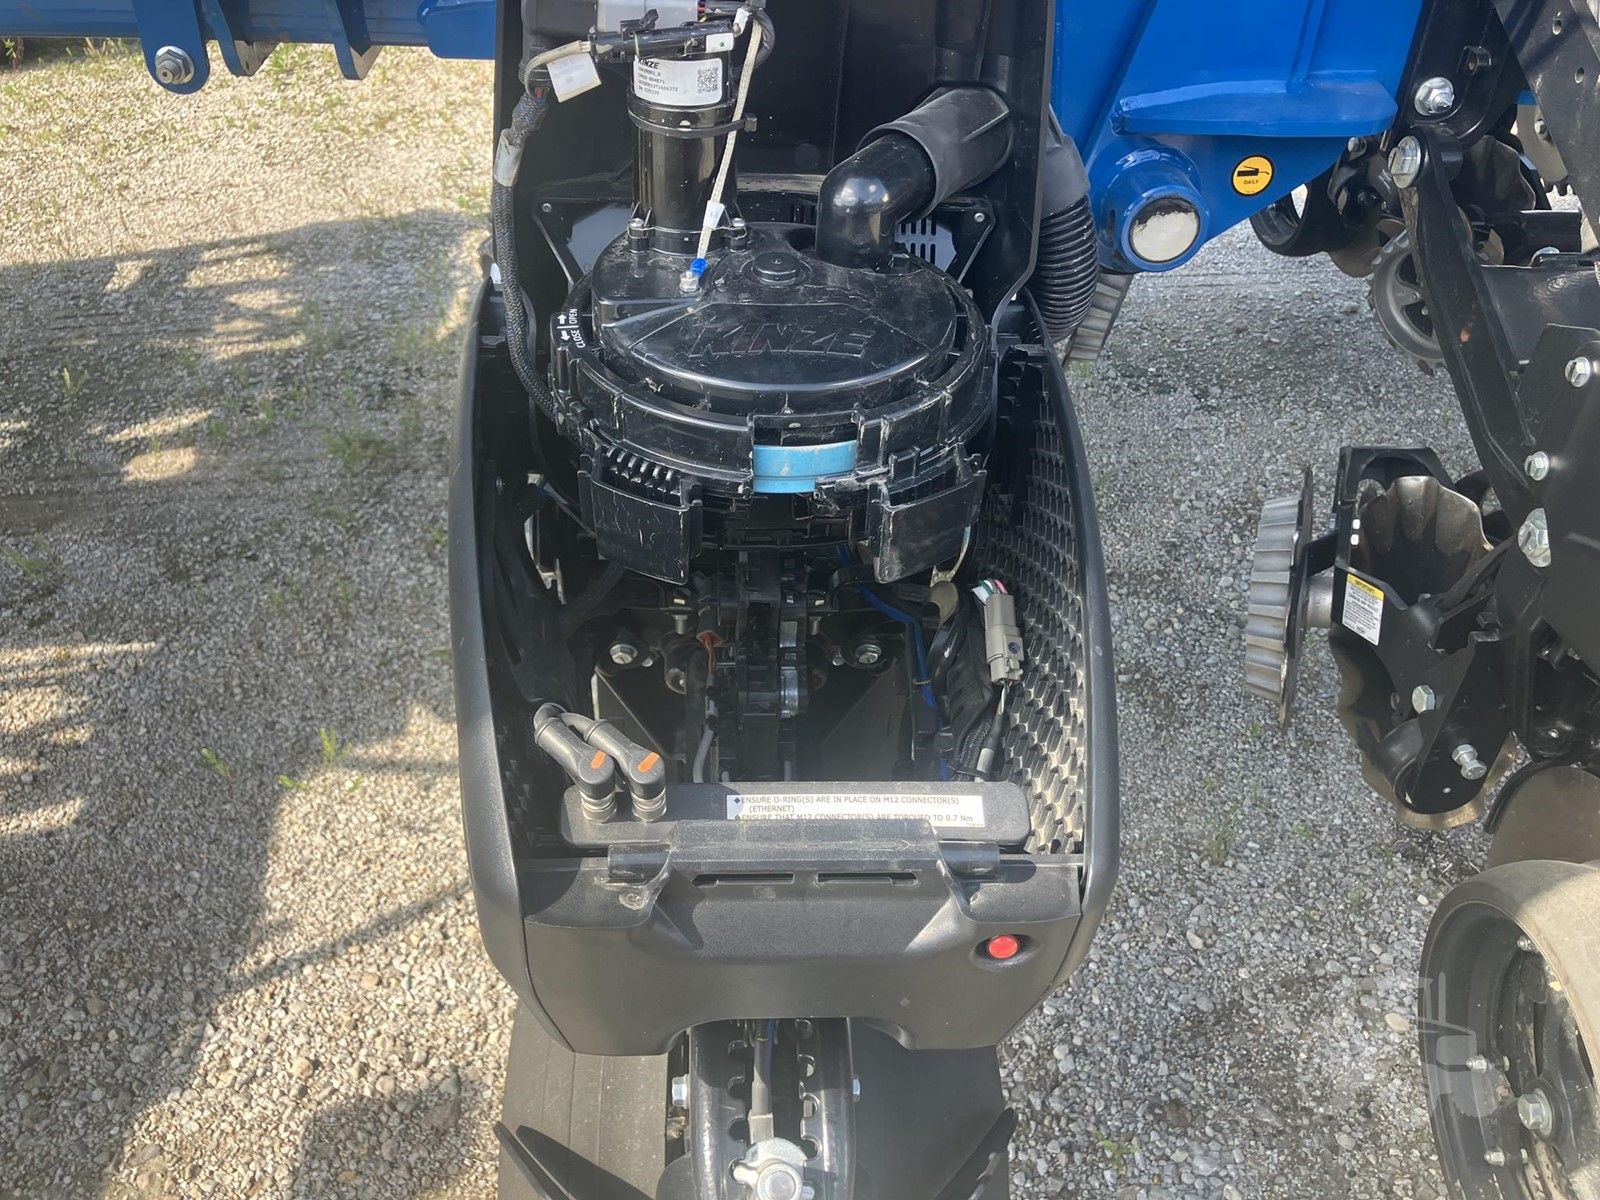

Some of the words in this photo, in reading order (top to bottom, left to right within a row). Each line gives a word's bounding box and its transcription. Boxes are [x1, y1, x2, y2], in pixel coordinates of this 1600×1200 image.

[568, 308, 578, 325] OPEN
[570, 329, 586, 348] CLOSE
[741, 796, 772, 804] ENSURE
[773, 796, 814, 805] O-RING(S)
[816, 796, 831, 804] ARE
[833, 796, 842, 804] IN
[844, 796, 868, 804] PLACE
[870, 796, 881, 804] ON
[883, 796, 899, 804] M12
[901, 796, 960, 805] CONNECTOR(S)
[749, 805, 795, 813] (ETHERNET)
[946, 814, 958, 822] 0.7
